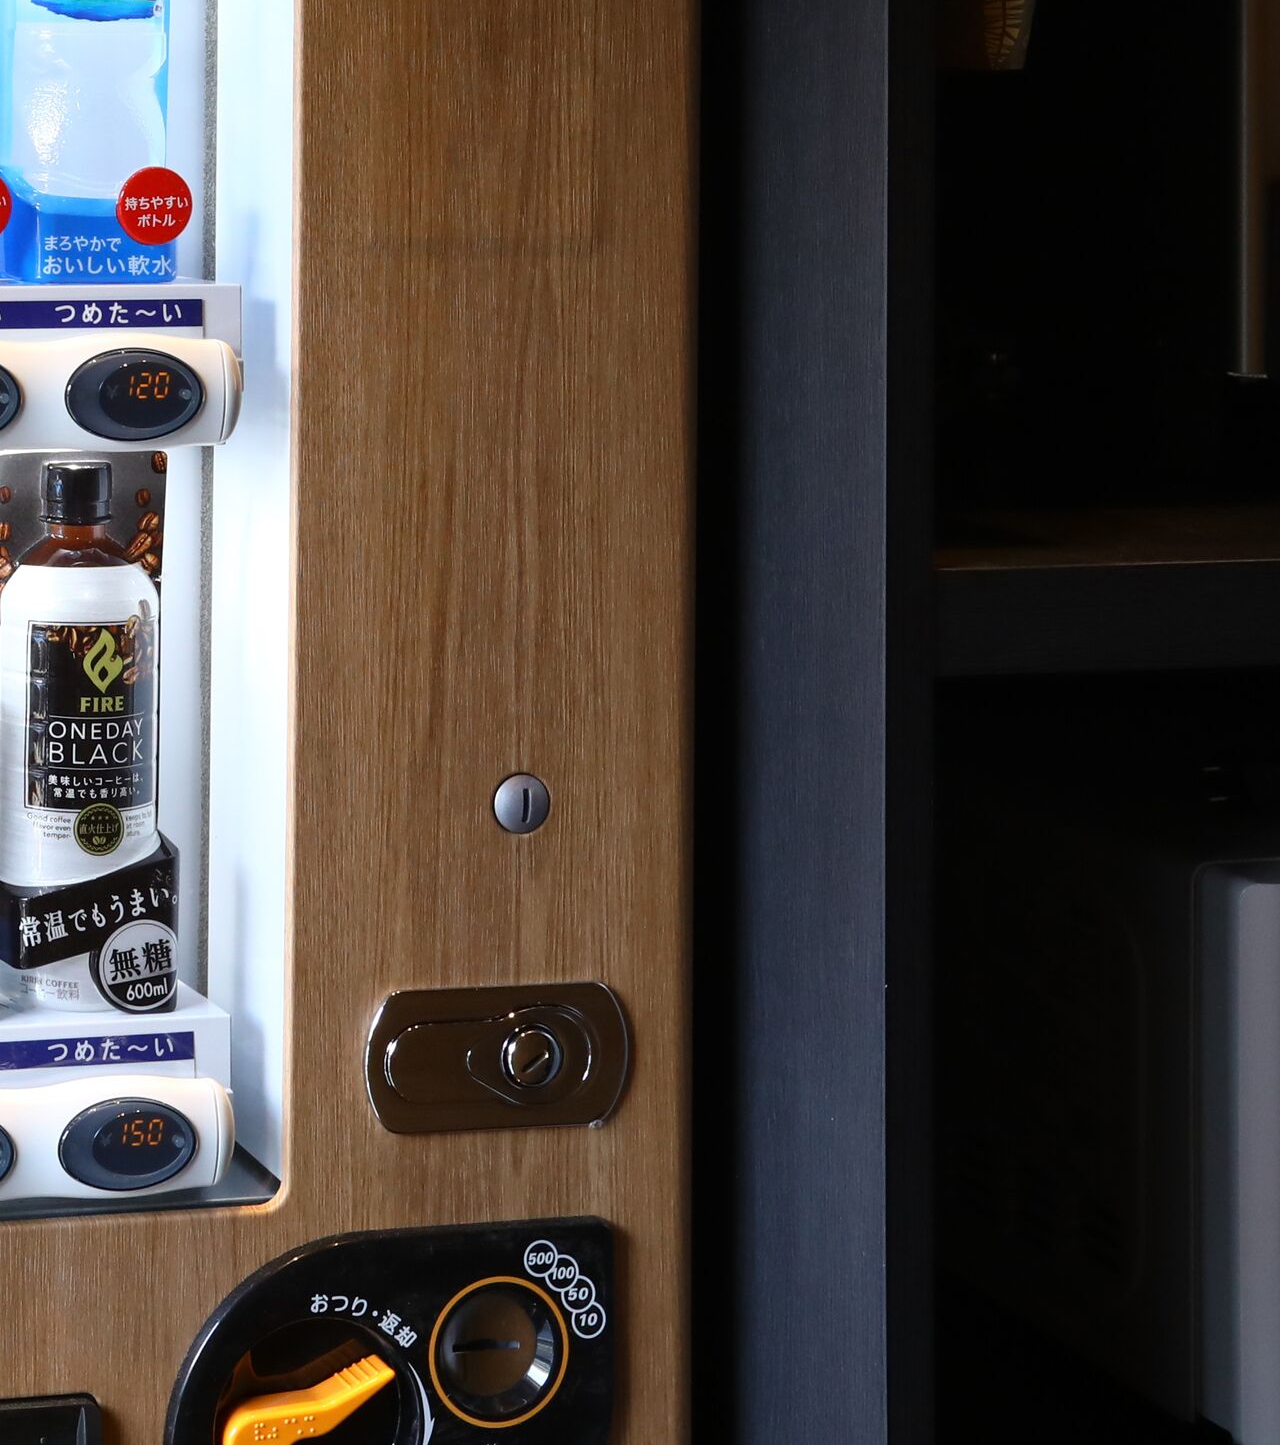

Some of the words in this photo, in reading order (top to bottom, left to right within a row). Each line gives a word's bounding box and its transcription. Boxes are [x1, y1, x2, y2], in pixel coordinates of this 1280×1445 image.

[129, 372, 170, 400] 120
[80, 697, 124, 712] FIRE
[48, 719, 143, 742] ONEDAY
[49, 740, 142, 764] BLACK
[109, 941, 172, 976] 無糖
[126, 980, 169, 1002] 600ml
[122, 1119, 163, 1145] 150
[528, 1252, 554, 1265] 500
[552, 1267, 574, 1280] 100
[568, 1288, 588, 1302] 50
[579, 1314, 598, 1326] 10
